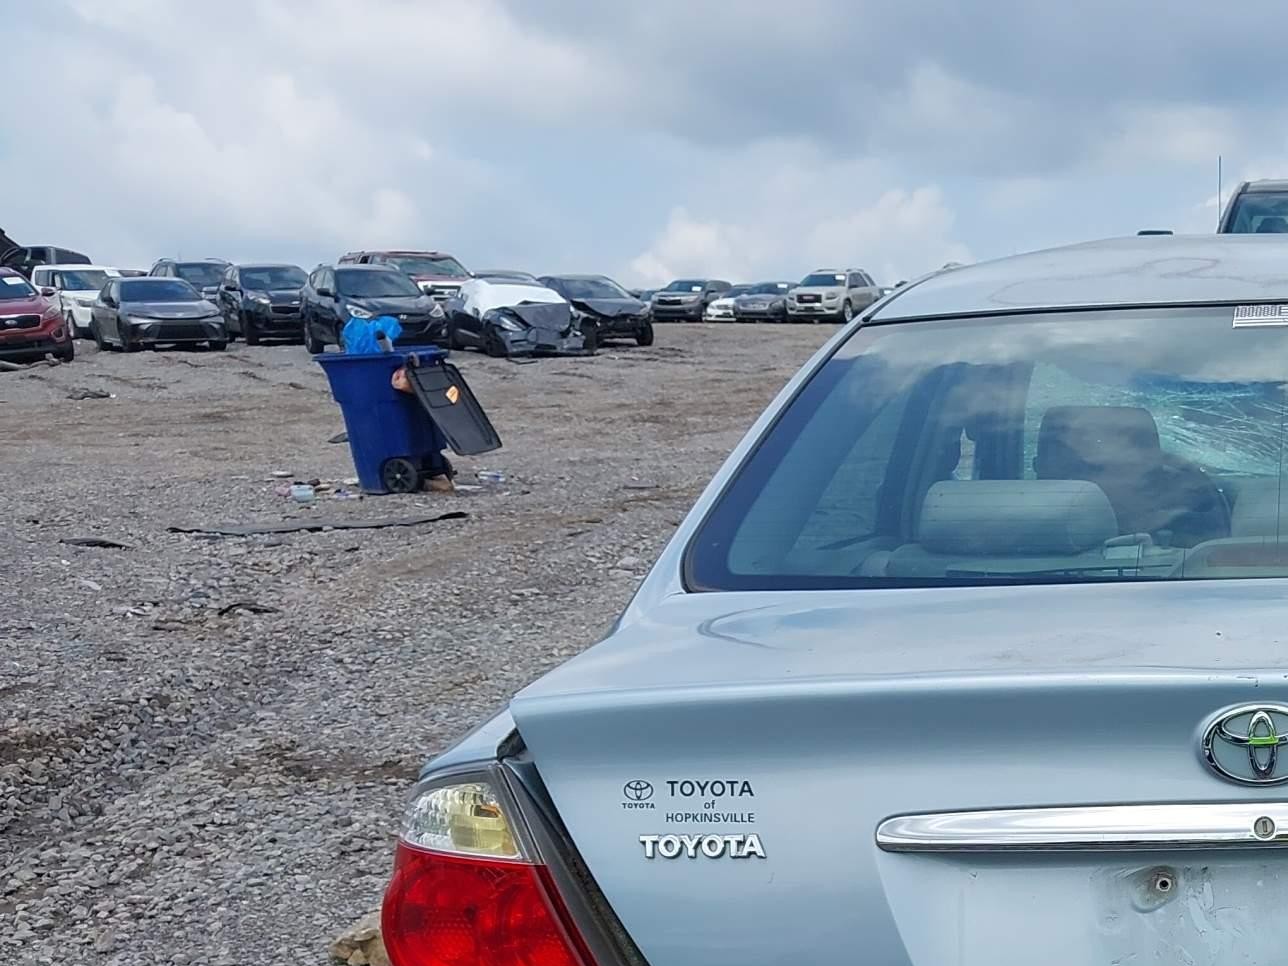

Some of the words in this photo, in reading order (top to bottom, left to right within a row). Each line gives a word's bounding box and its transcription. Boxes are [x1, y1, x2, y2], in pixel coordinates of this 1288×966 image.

[666, 780, 755, 797] TOYOTA
[621, 802, 656, 810] TOYOTA
[703, 799, 716, 810] of
[665, 812, 756, 824] HOPKINSVILLE
[639, 832, 768, 859] TOYOTA
